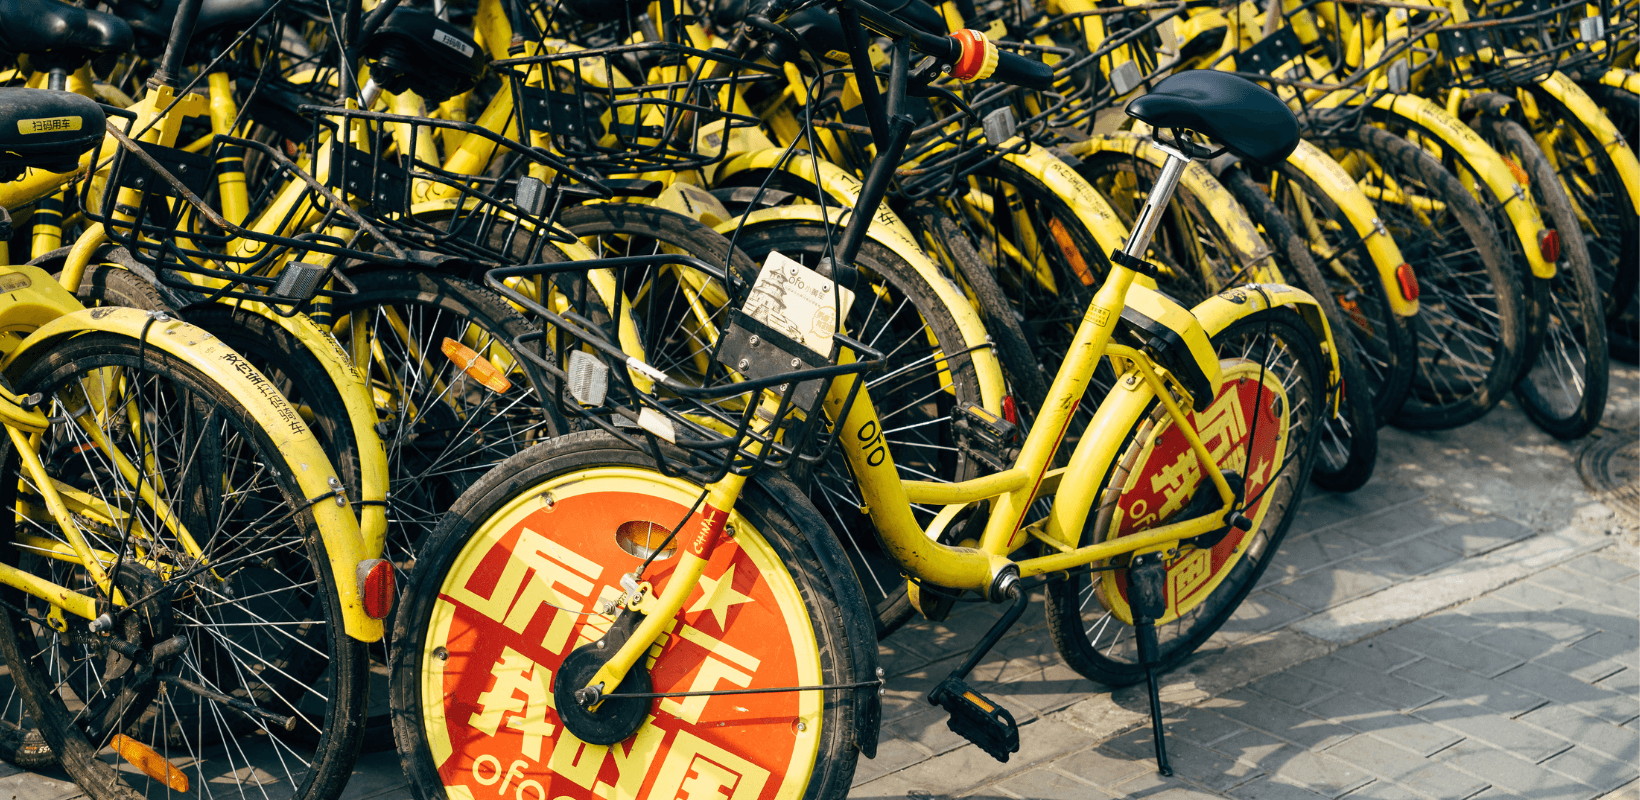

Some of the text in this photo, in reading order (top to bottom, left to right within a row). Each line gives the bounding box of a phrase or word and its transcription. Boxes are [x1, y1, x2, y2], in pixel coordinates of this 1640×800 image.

[32, 118, 71, 132] 扫码用车
[788, 276, 805, 289] ofo
[857, 420, 886, 467] ofo
[693, 510, 716, 555] CHINA
[1129, 499, 1157, 531] of
[472, 754, 546, 800] ofo
